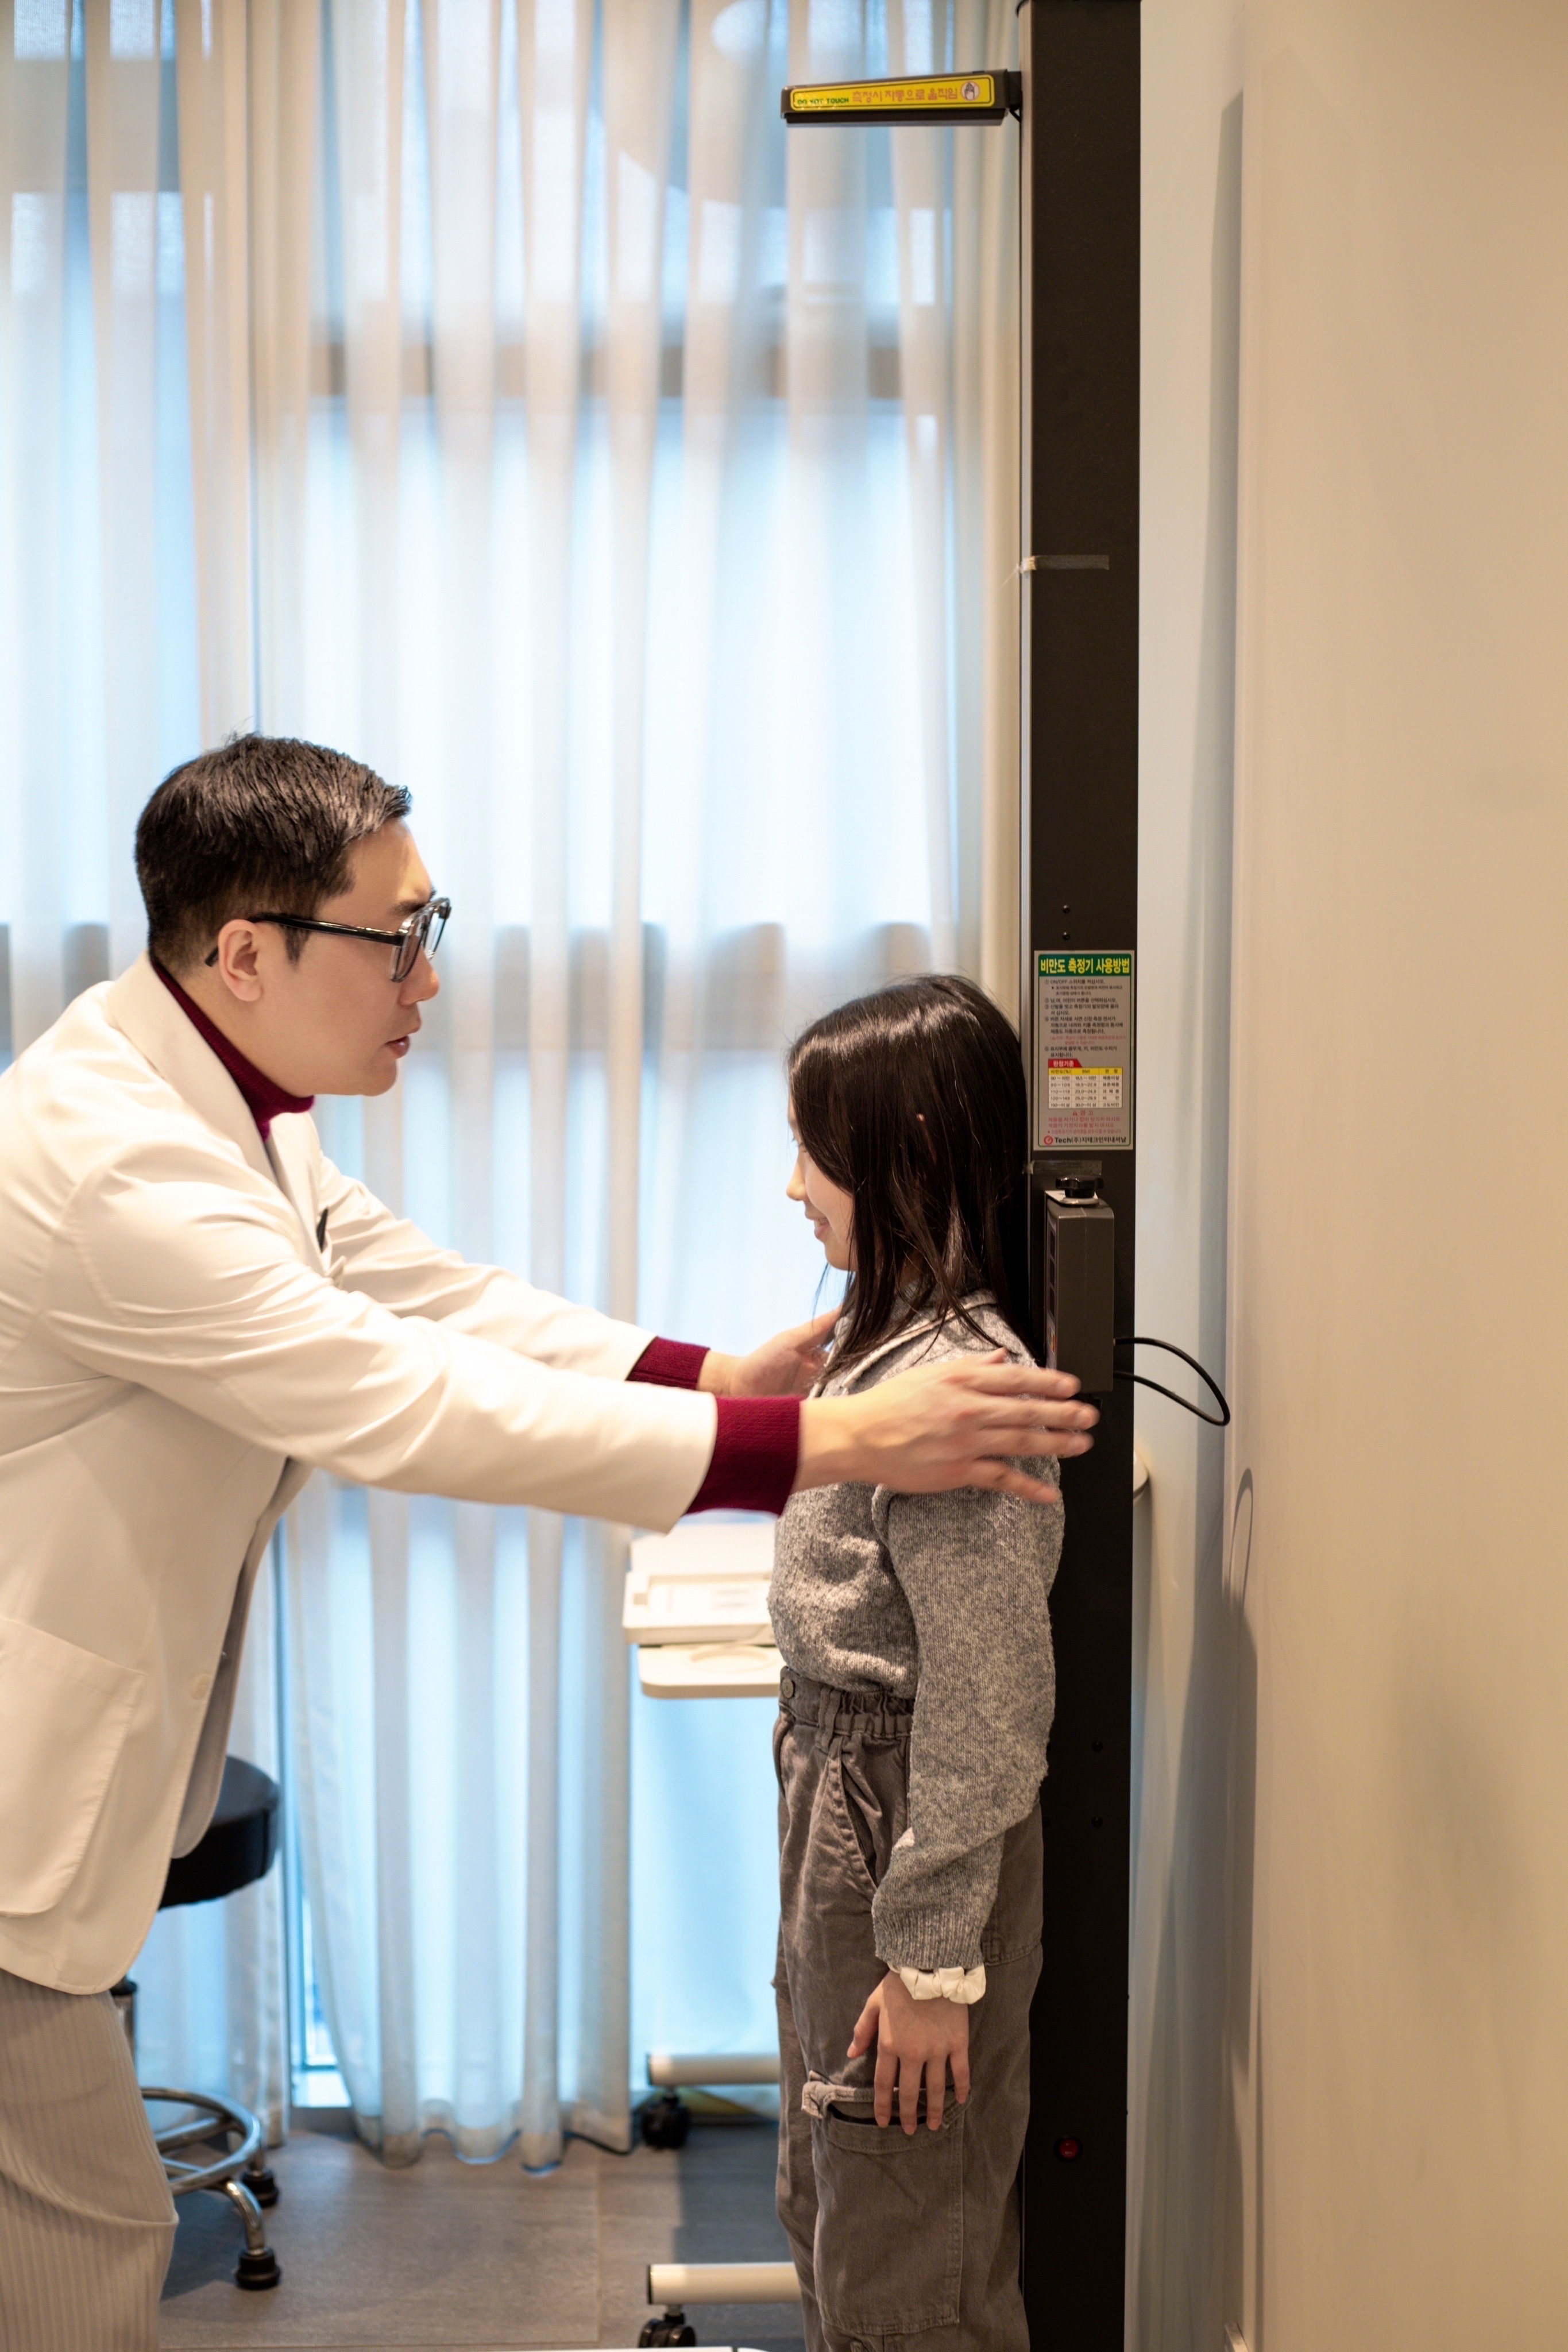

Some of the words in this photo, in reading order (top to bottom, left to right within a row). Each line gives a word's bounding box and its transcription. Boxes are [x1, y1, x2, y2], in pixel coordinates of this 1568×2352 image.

[852, 91, 882, 103] 측정시
[885, 89, 925, 102] 자동으로
[928, 87, 958, 101] 움직임
[1040, 957, 1066, 974] 비만도
[1068, 957, 1094, 974] 측정기
[1096, 957, 1130, 974] 사용방법
